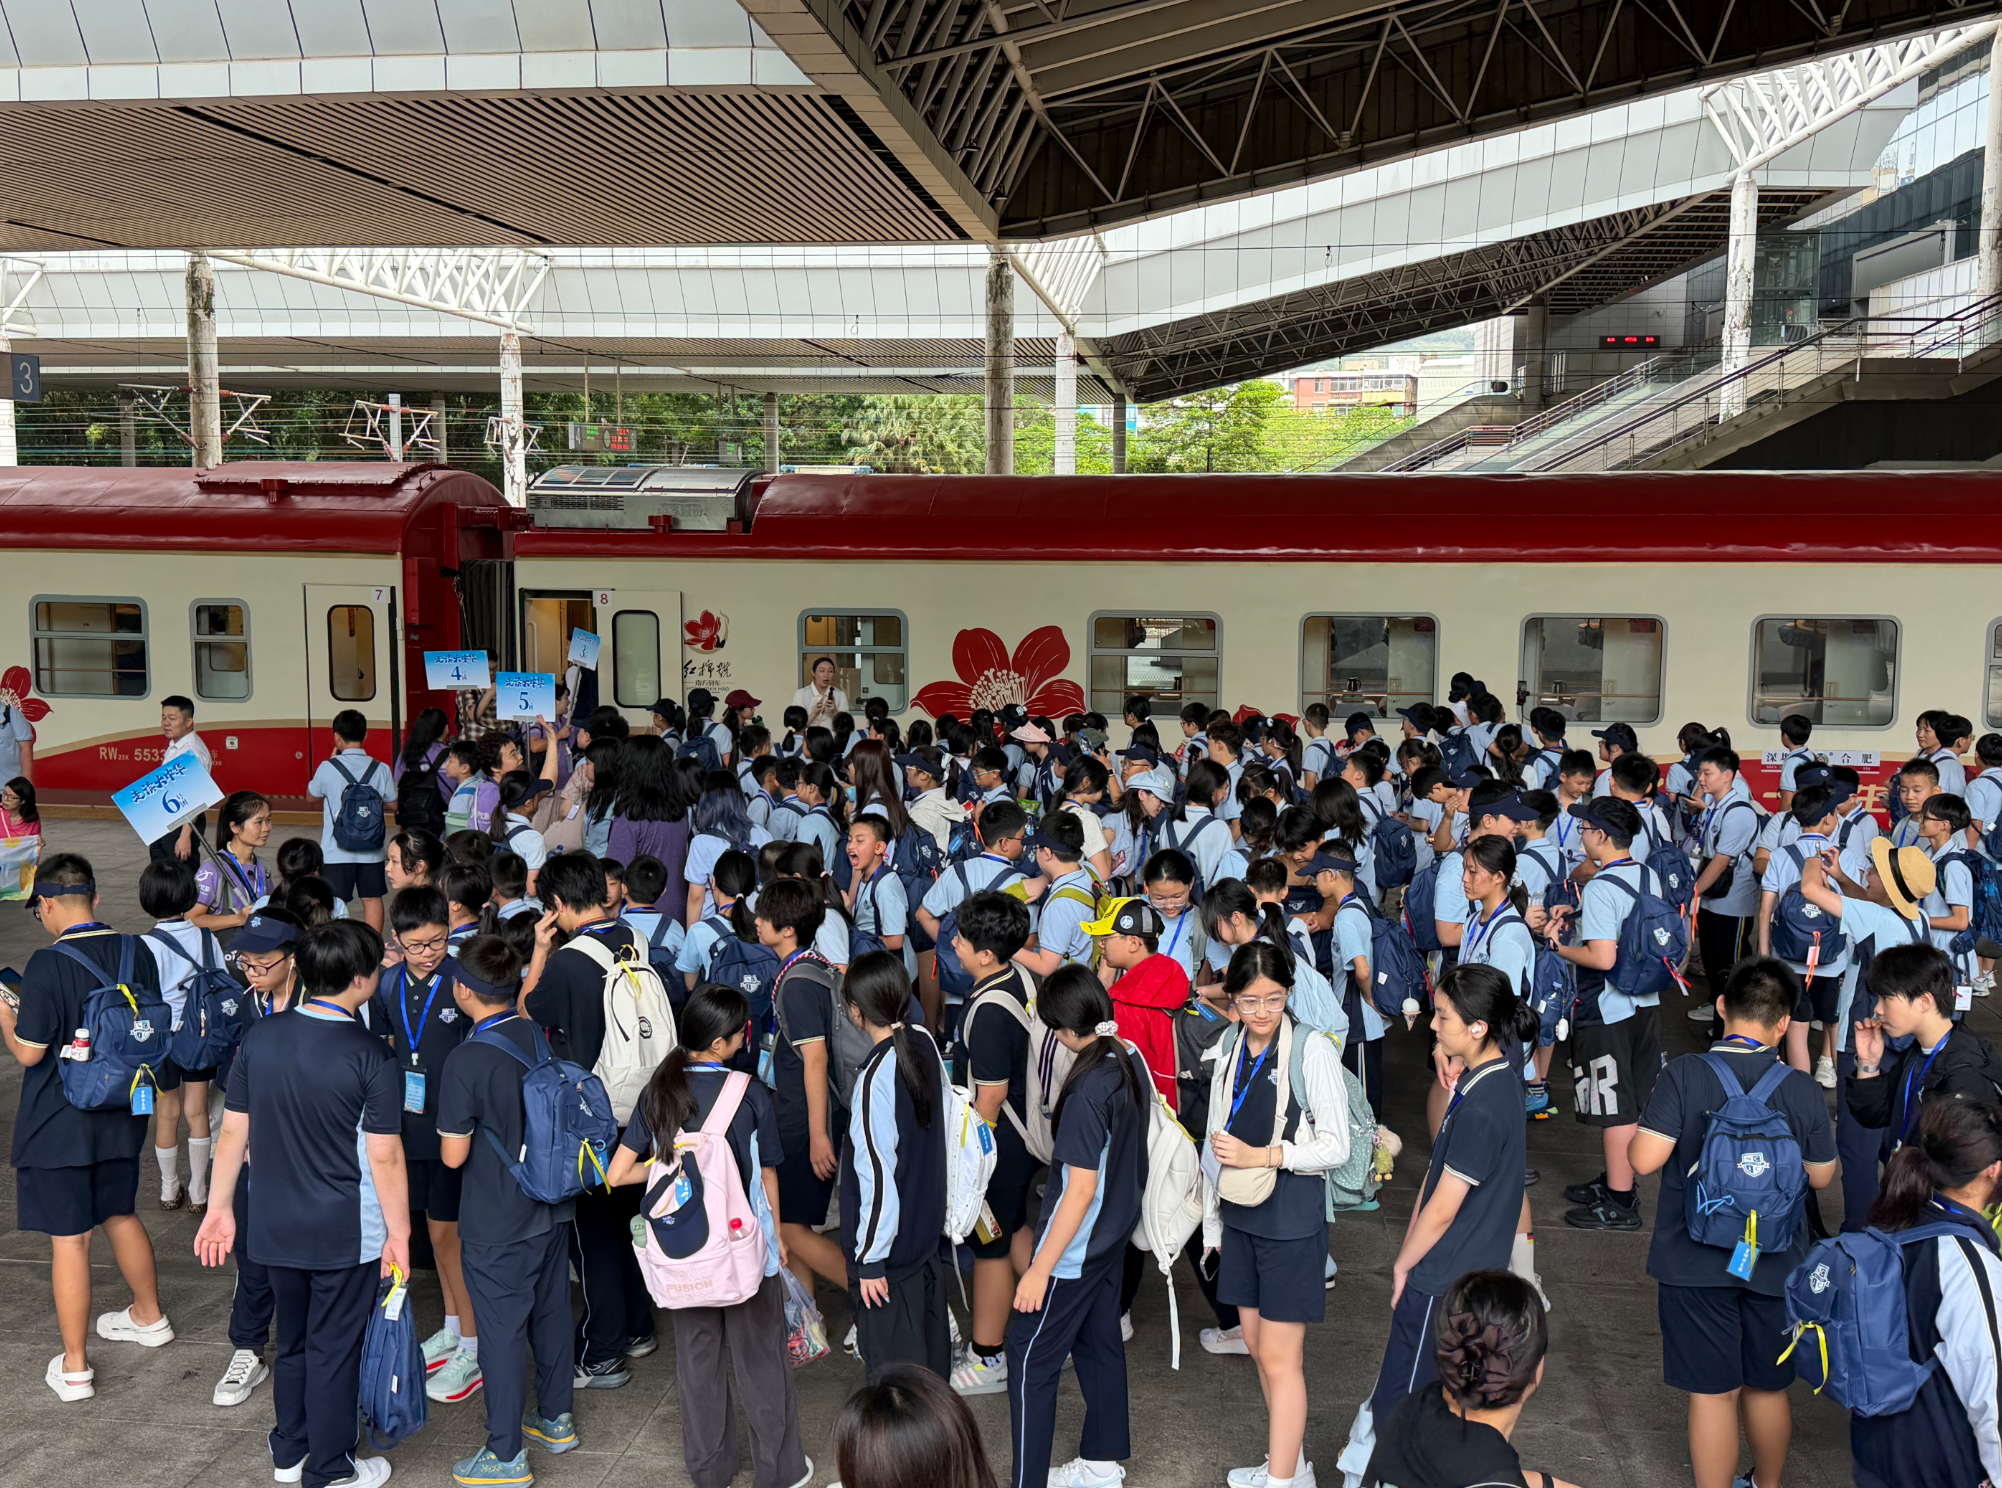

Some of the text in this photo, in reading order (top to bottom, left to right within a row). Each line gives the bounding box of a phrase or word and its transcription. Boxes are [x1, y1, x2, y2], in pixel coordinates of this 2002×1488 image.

[20, 361, 33, 394] 3
[375, 589, 383, 601] 7
[600, 593, 608, 605] 8
[450, 665, 462, 681] 4
[518, 691, 529, 711] 5
[1841, 752, 1872, 764] 合肥
[131, 762, 188, 803] 走读大中华
[162, 790, 181, 814] 6
[665, 1280, 713, 1293] FUSION
